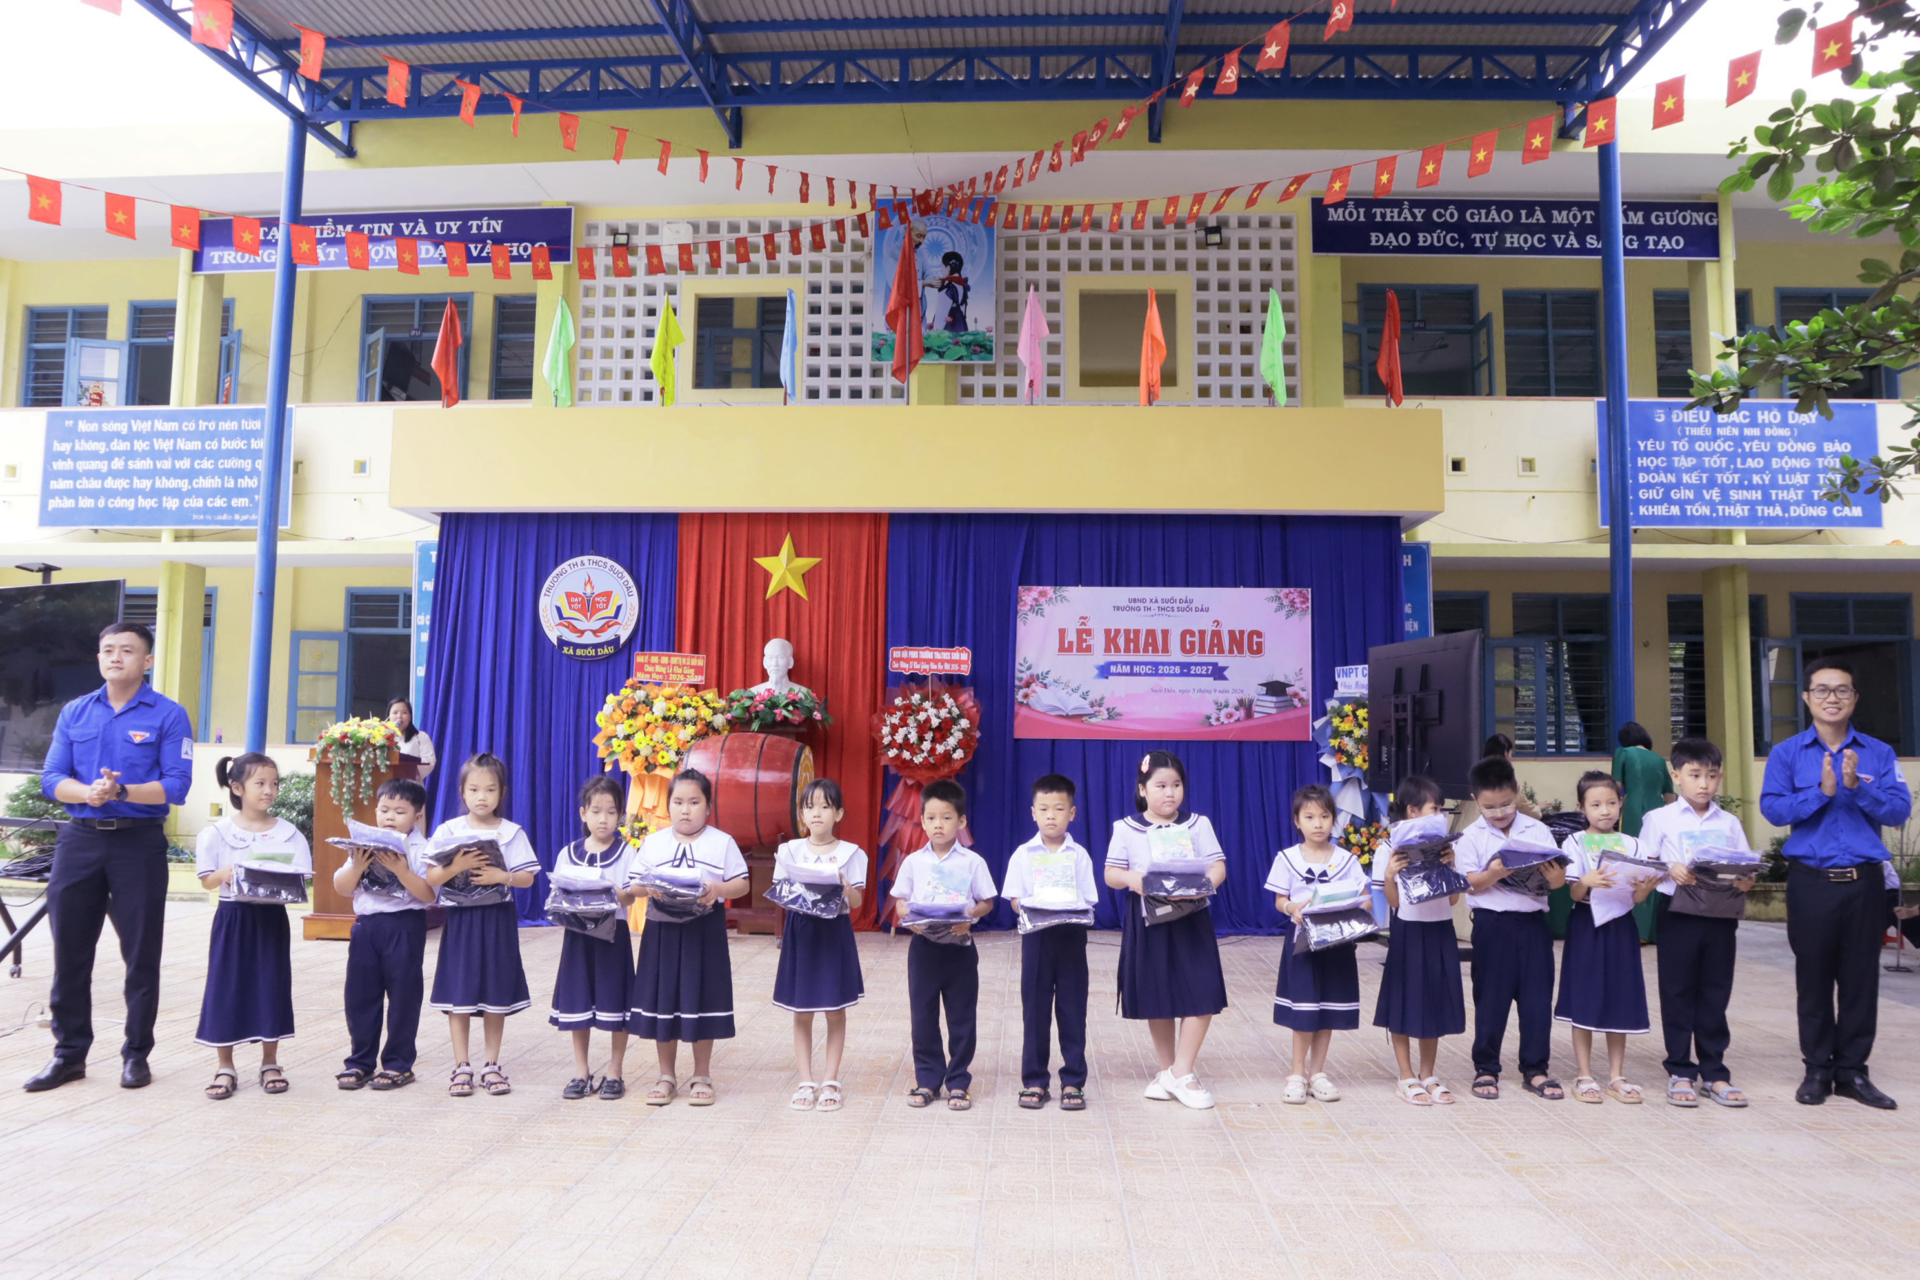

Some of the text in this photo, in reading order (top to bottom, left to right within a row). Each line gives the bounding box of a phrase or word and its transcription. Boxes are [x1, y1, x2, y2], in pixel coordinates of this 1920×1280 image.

[1327, 201, 1366, 222] MỖI
[1372, 201, 1426, 222] THẦY
[1432, 205, 1459, 223] CÔ
[1466, 206, 1514, 223] GIÁO
[1520, 206, 1546, 224] LÀ
[1552, 207, 1595, 227] MỘT
[1651, 209, 1719, 226] GƯƠNG
[359, 217, 503, 236] TIN VÀ UY TÍN
[1370, 232, 1411, 249] ĐẠO
[1418, 230, 1465, 249] ĐỨC,
[1471, 231, 1499, 250] TỰ
[1505, 233, 1546, 250] HỌC
[1552, 231, 1580, 248] VÀ
[1644, 235, 1685, 252] TẠO
[1654, 410, 1665, 422] 5
[131, 419, 152, 434] Việt
[153, 419, 178, 431] Nam
[182, 419, 196, 431] có
[1717, 426, 1739, 436] NIÊN
[1744, 427, 1760, 436] NHI
[53, 440, 72, 454] hay
[133, 439, 150, 452] tộc
[153, 438, 174, 452] Việt
[176, 438, 201, 450] Nam
[205, 438, 218, 450] có
[1637, 438, 1665, 451] YÊU
[1823, 439, 1851, 453] BÀO
[52, 459, 74, 470] vinh
[76, 460, 108, 472] quang
[127, 457, 153, 469] sánh
[156, 458, 172, 469] vai
[175, 457, 191, 469] với
[194, 457, 214, 469] các
[1637, 457, 1667, 470] HỌC
[1672, 455, 1697, 469] TẬP
[1772, 456, 1811, 470] ĐỘNG
[133, 476, 153, 491] hay
[225, 476, 235, 488] là
[1638, 470, 1676, 483] ĐOÀN
[1682, 470, 1709, 483] KẾT
[1778, 472, 1810, 486] LUẬT
[1639, 486, 1664, 499] GIỮ
[1670, 486, 1694, 499] GÌN
[1702, 487, 1721, 502] VỆ
[1729, 489, 1761, 500] SINH
[1769, 488, 1804, 502] THẬT
[137, 496, 159, 510] học
[162, 496, 179, 510] tập
[207, 496, 228, 507] các
[1639, 503, 1680, 516] KHIÊM
[567, 560, 578, 570] TH
[587, 559, 608, 569] THCS
[1160, 596, 1178, 604] SUỐI
[1112, 604, 1141, 612] TRƯỜNG
[1176, 604, 1193, 612] SUỐI
[1057, 615, 1265, 657] LỄ KHAI GIẢNG
[1110, 663, 1131, 674] NĂM
[1133, 665, 1155, 676] HỌC:
[1158, 665, 1181, 674] 2026
[1190, 665, 1213, 675] 2027
[1336, 666, 1359, 679] VNPT
